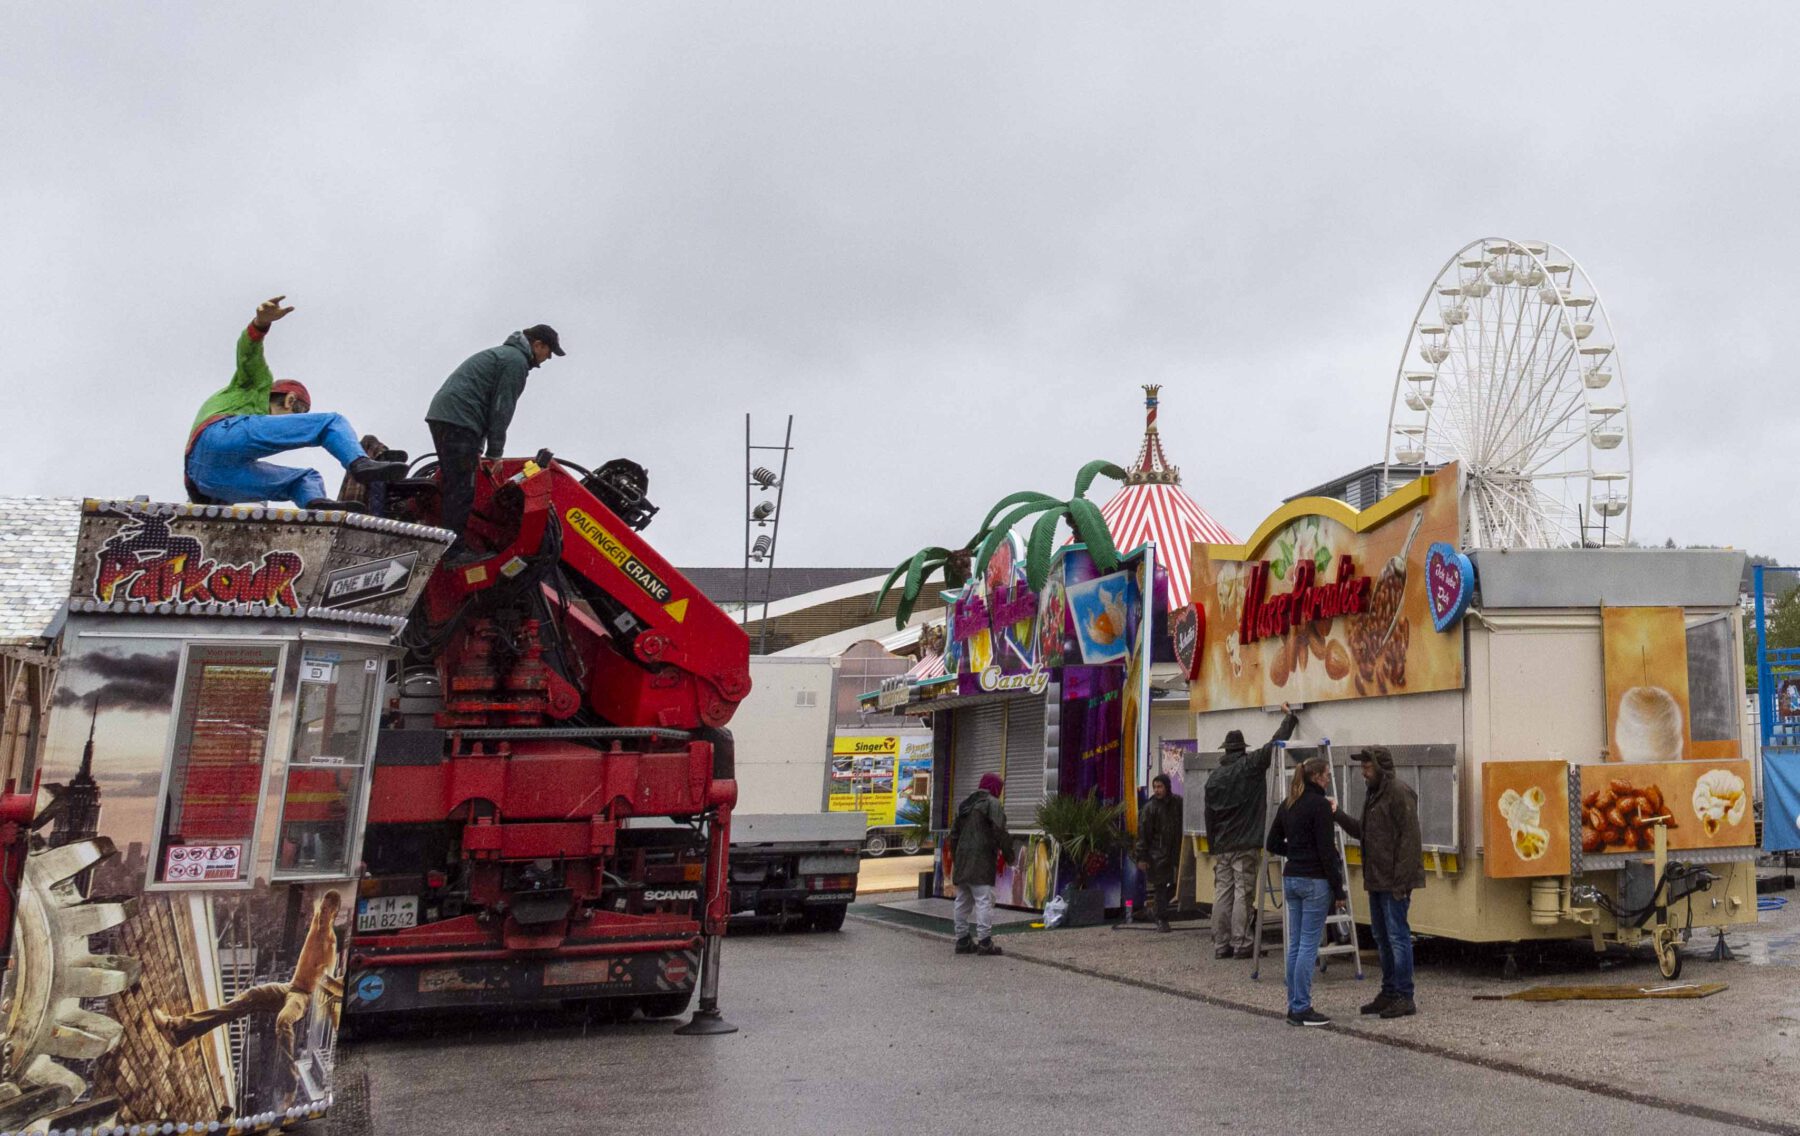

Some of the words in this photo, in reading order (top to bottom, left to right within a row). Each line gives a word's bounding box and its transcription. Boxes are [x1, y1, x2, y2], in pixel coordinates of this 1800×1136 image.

[569, 510, 628, 564] PALFINGER
[625, 560, 669, 600] CRANE
[333, 576, 362, 594] ONE
[363, 568, 388, 588] WAY
[980, 663, 1049, 694] Candy
[855, 742, 884, 752] Singer
[204, 869, 236, 879] WARNING
[643, 890, 698, 901] SCANIA
[385, 898, 396, 912] M
[360, 915, 377, 929] HA
